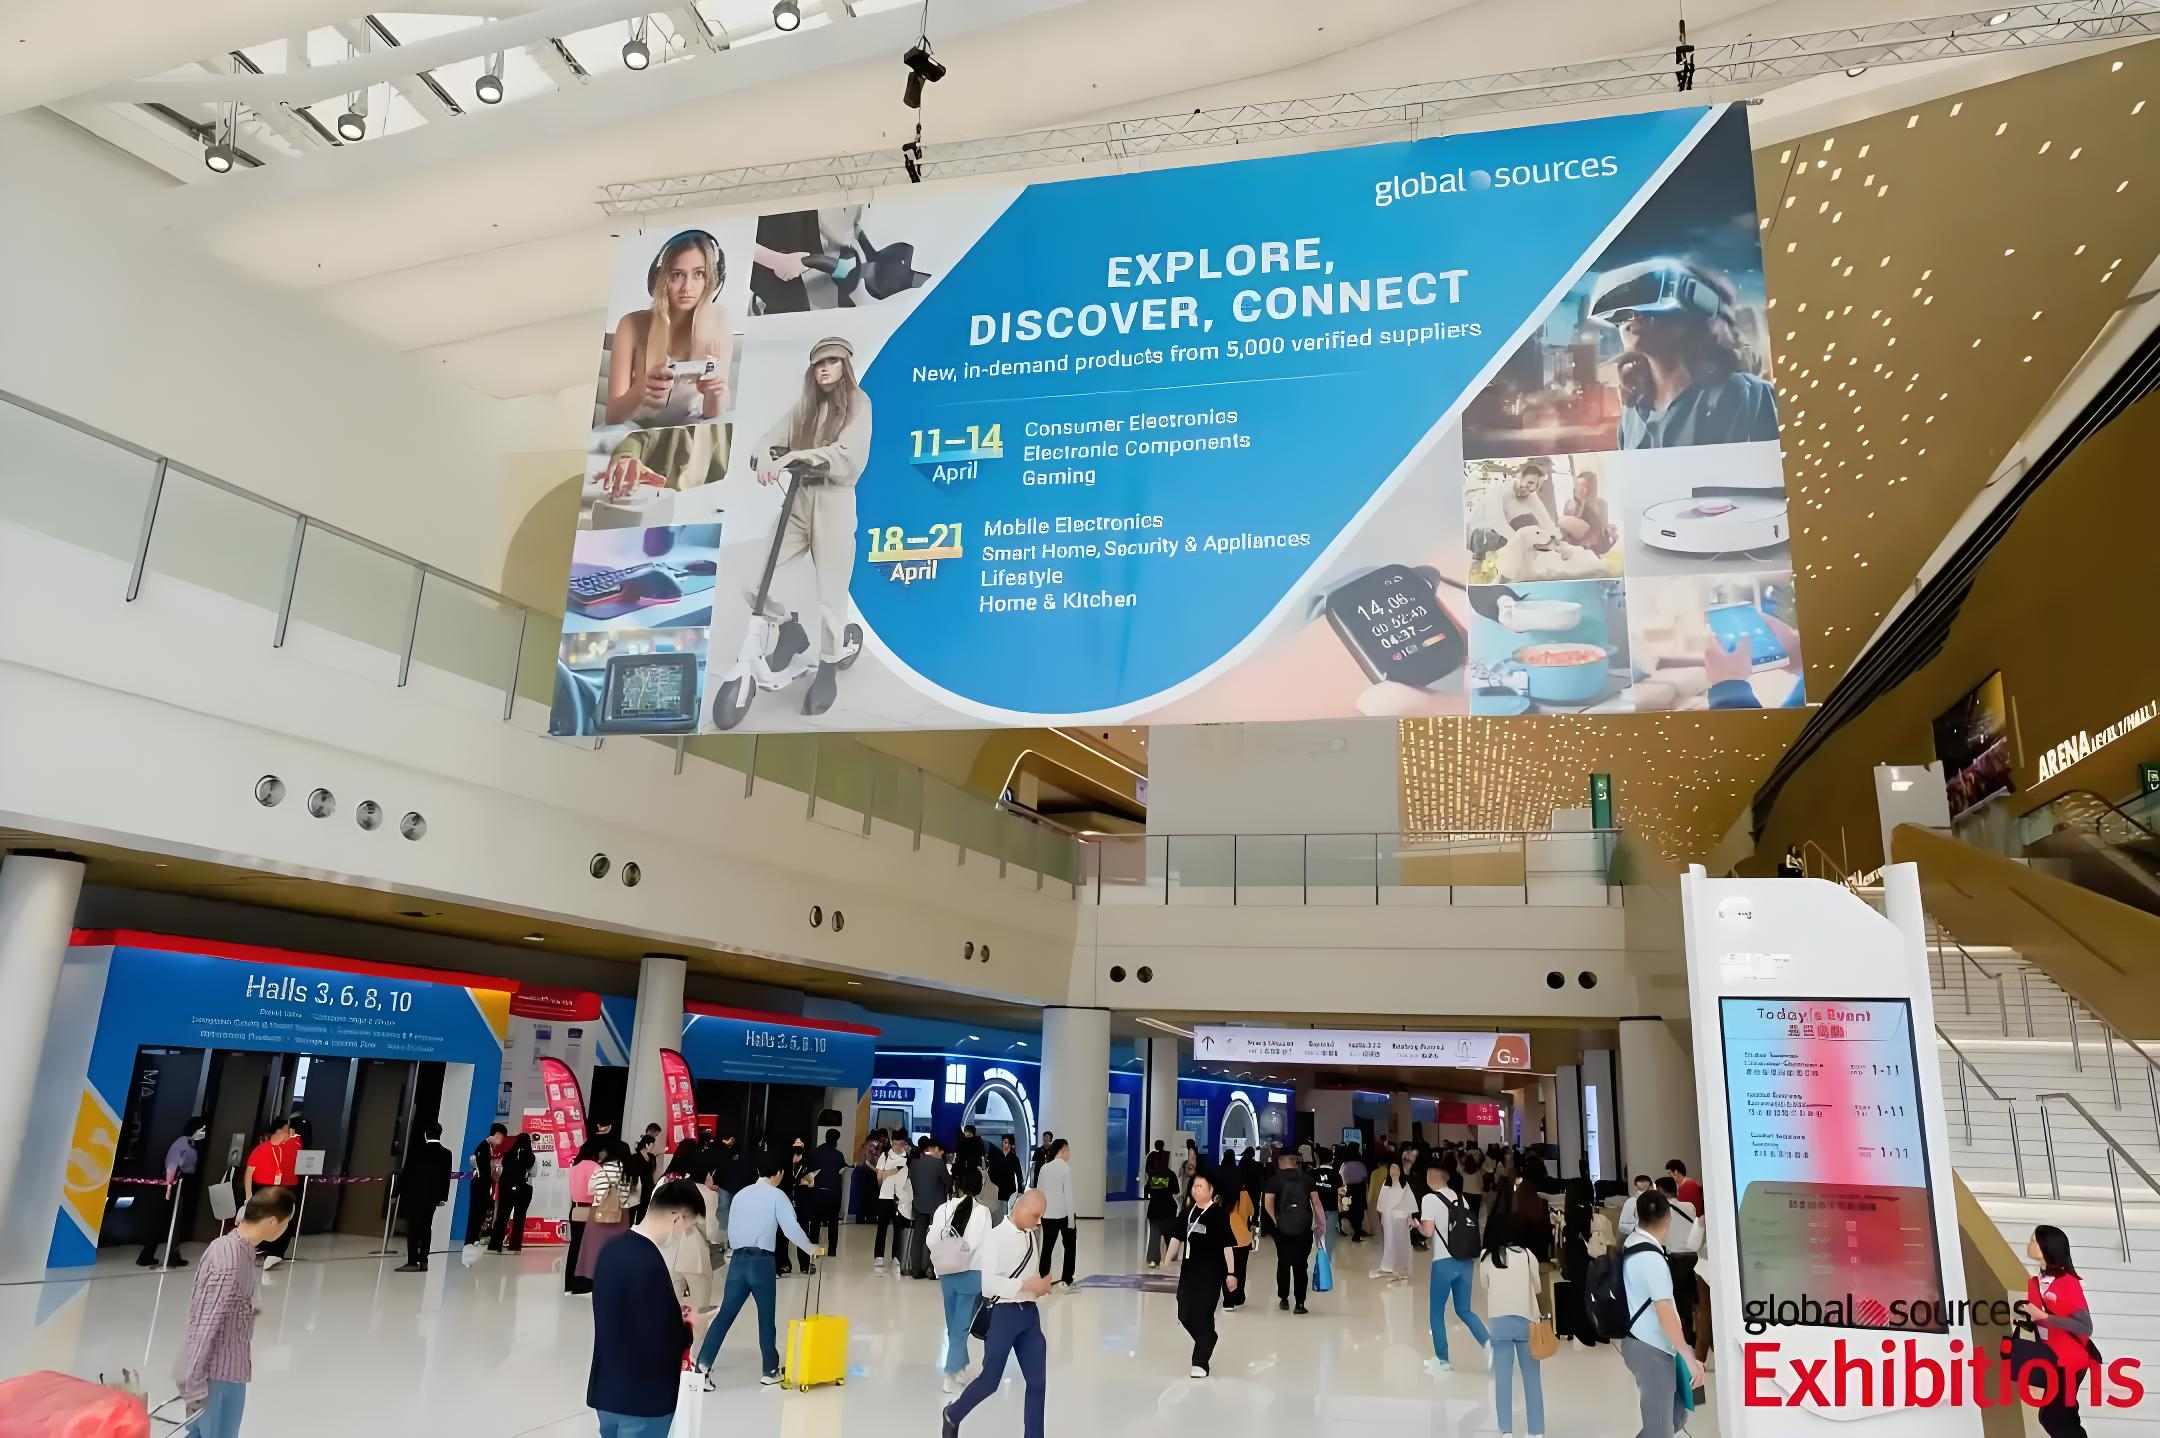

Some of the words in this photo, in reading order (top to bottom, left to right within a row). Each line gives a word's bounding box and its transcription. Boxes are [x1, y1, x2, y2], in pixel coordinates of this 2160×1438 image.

[1374, 166, 1467, 207] global
[1493, 154, 1619, 187] sources
[1106, 237, 1335, 289] EXPLORE,
[968, 298, 1215, 347] DISCOVER,
[1232, 269, 1470, 323] CONNECT
[911, 365, 958, 384] New,
[963, 356, 1069, 380] in-demand
[1075, 348, 1163, 375] products
[1170, 342, 1220, 363] from
[1226, 336, 1286, 360] 5,000
[1291, 328, 1374, 352] verified
[1379, 319, 1482, 346] suppliers
[1024, 416, 1124, 437] Consumer
[1128, 408, 1239, 431] Electronics
[1023, 438, 1119, 461] Electronic
[1123, 433, 1252, 459] Components
[931, 460, 978, 485] April
[1022, 466, 1097, 488] Gaming
[983, 516, 1050, 538] Mobile
[1055, 511, 1164, 534] Electronics
[982, 542, 1037, 561] Smart
[1041, 540, 1101, 561] Home,
[1103, 535, 1179, 560] Security
[1184, 534, 1198, 553] &
[1202, 528, 1311, 554] Appliances
[889, 559, 938, 584] April
[980, 565, 1064, 588] Lifestyle
[979, 592, 1038, 613] Home
[1043, 592, 1057, 611] &
[1062, 588, 1137, 611] Kitchen
[2038, 730, 2090, 783] ARENA
[245, 974, 308, 1003] Halls
[314, 983, 334, 1006] 3,
[340, 985, 359, 1008] 6,
[364, 988, 382, 1011] 8,
[390, 991, 412, 1012] 10
